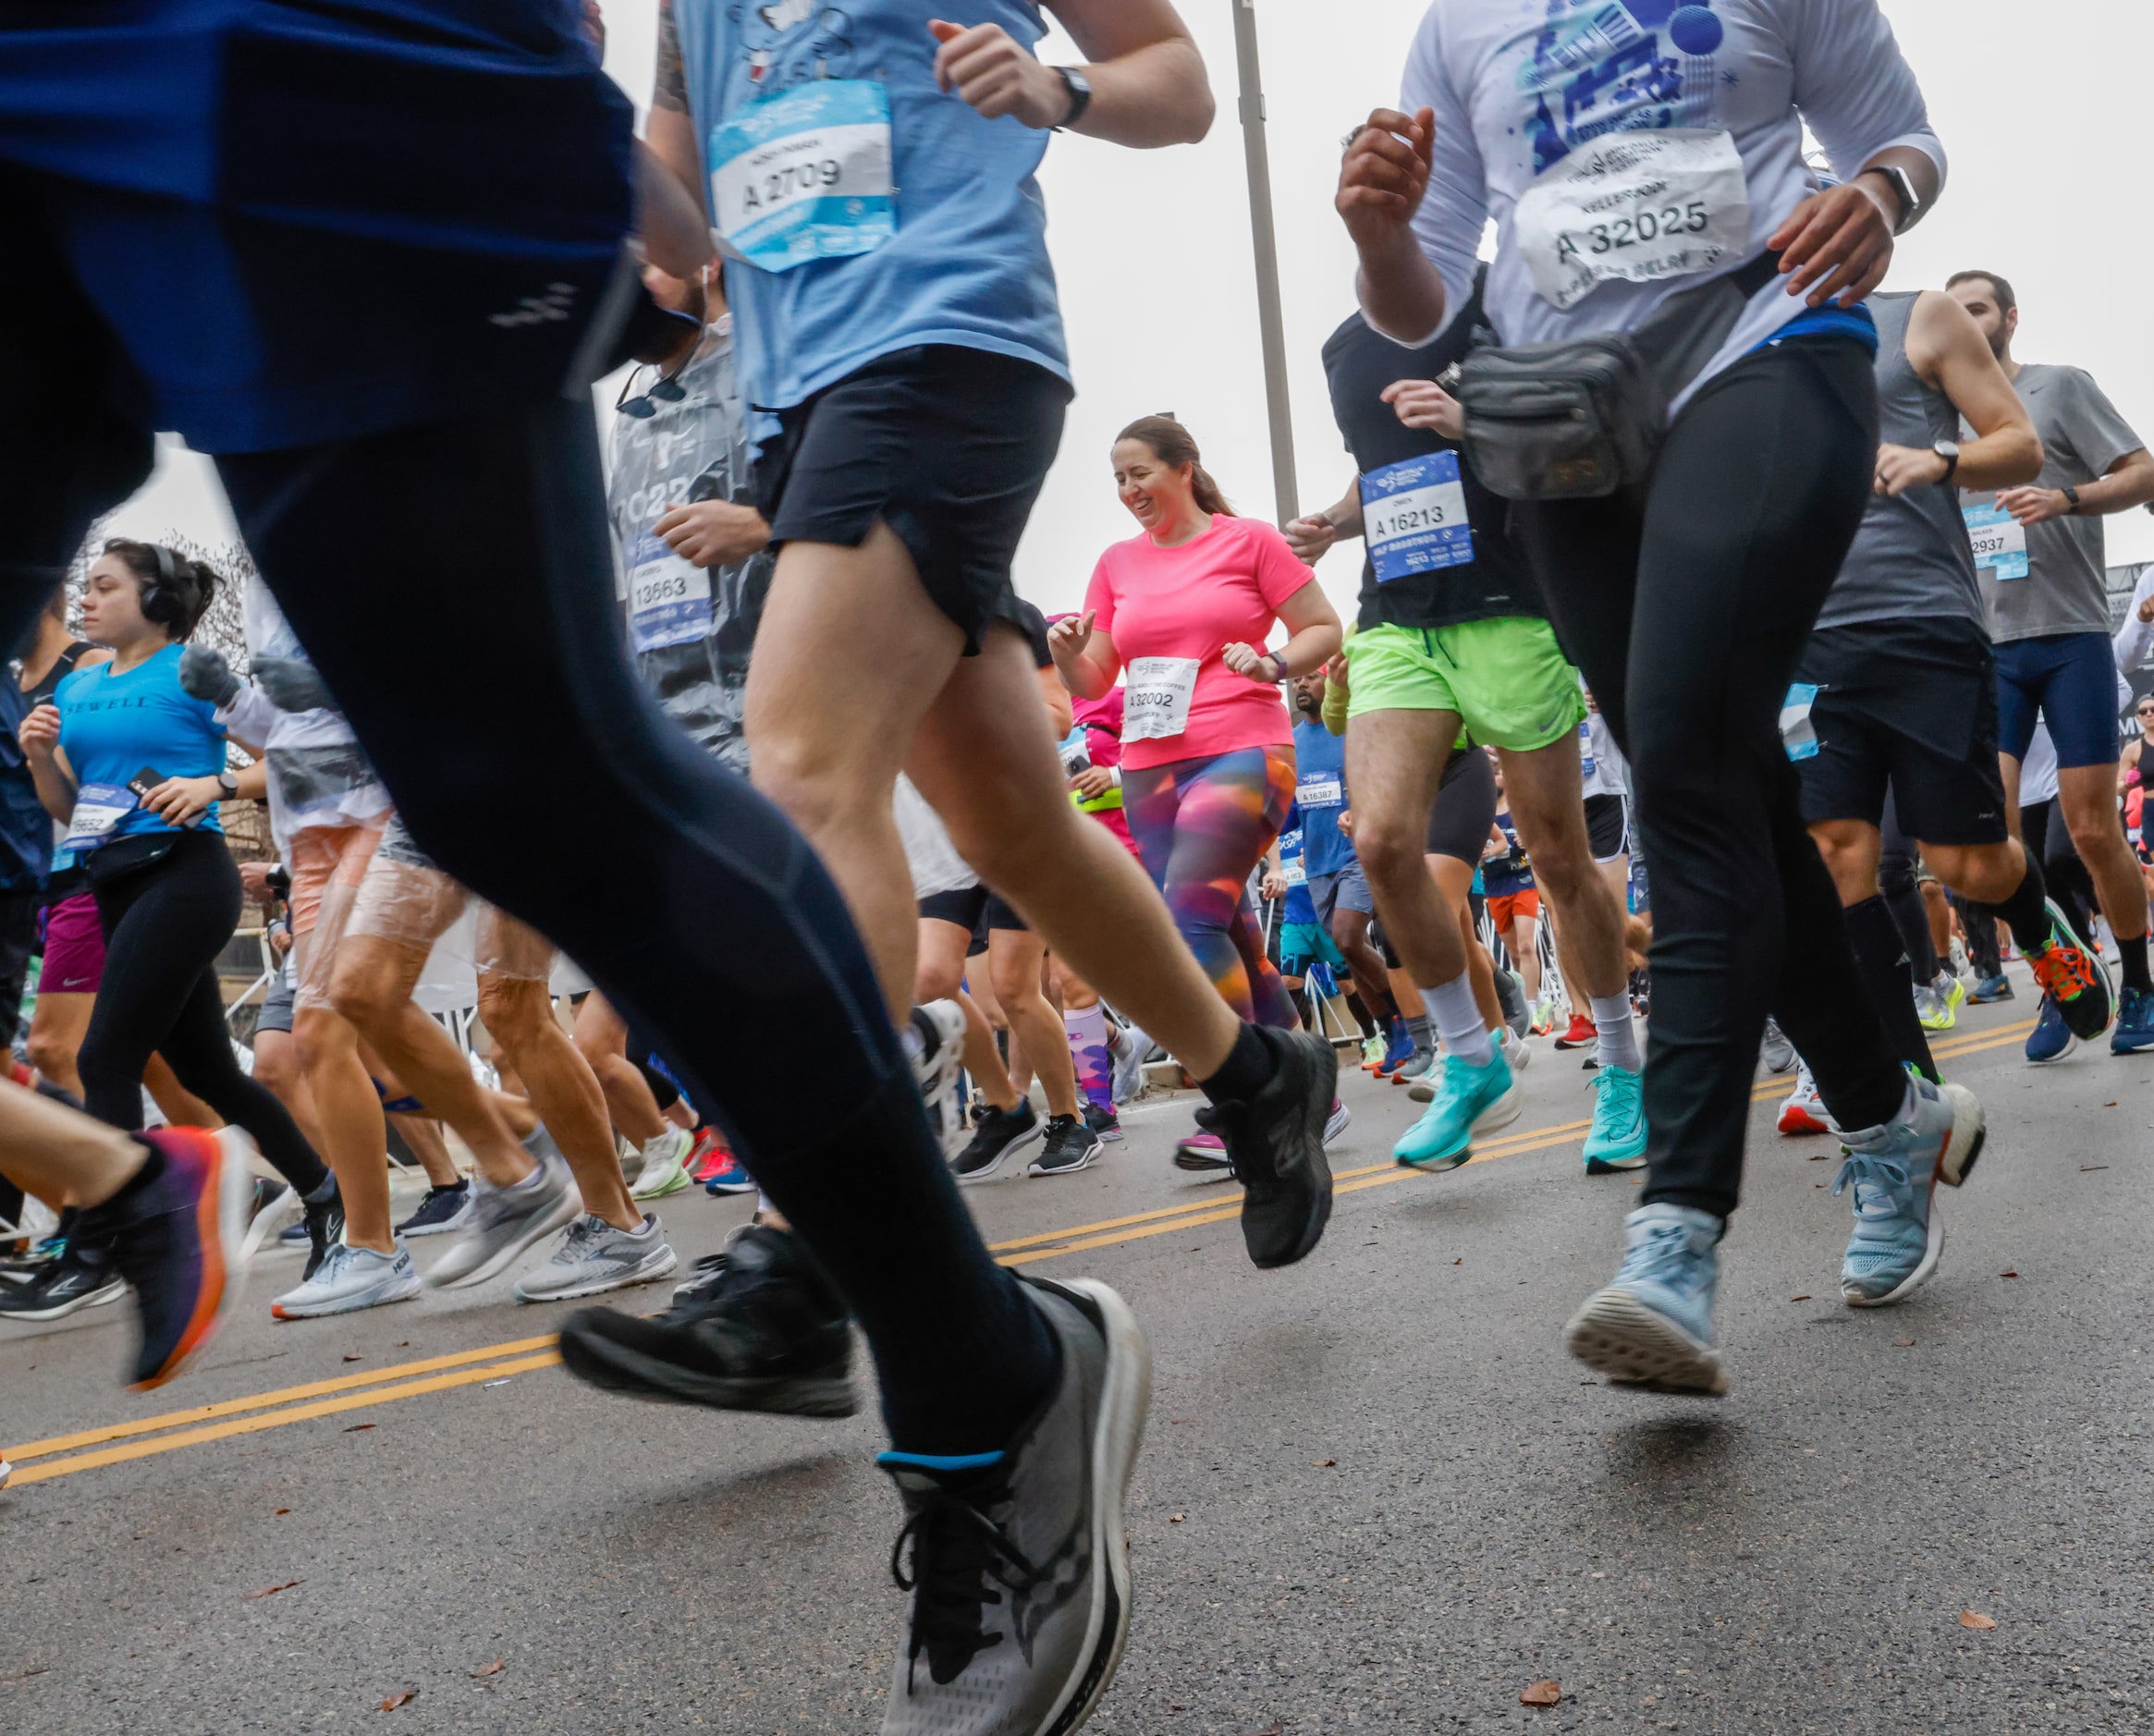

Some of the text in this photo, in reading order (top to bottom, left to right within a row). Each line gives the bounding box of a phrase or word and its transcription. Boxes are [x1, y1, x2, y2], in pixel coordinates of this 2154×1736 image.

[742, 159, 842, 214] A 2709
[1557, 202, 1707, 264] A 32025
[1376, 506, 1444, 537] A 16213
[1972, 537, 2004, 554] 2937
[636, 577, 687, 606] 13663
[64, 697, 149, 717] SEWELL
[1130, 692, 1173, 709] A 32002
[1303, 790, 1332, 801] A 16387
